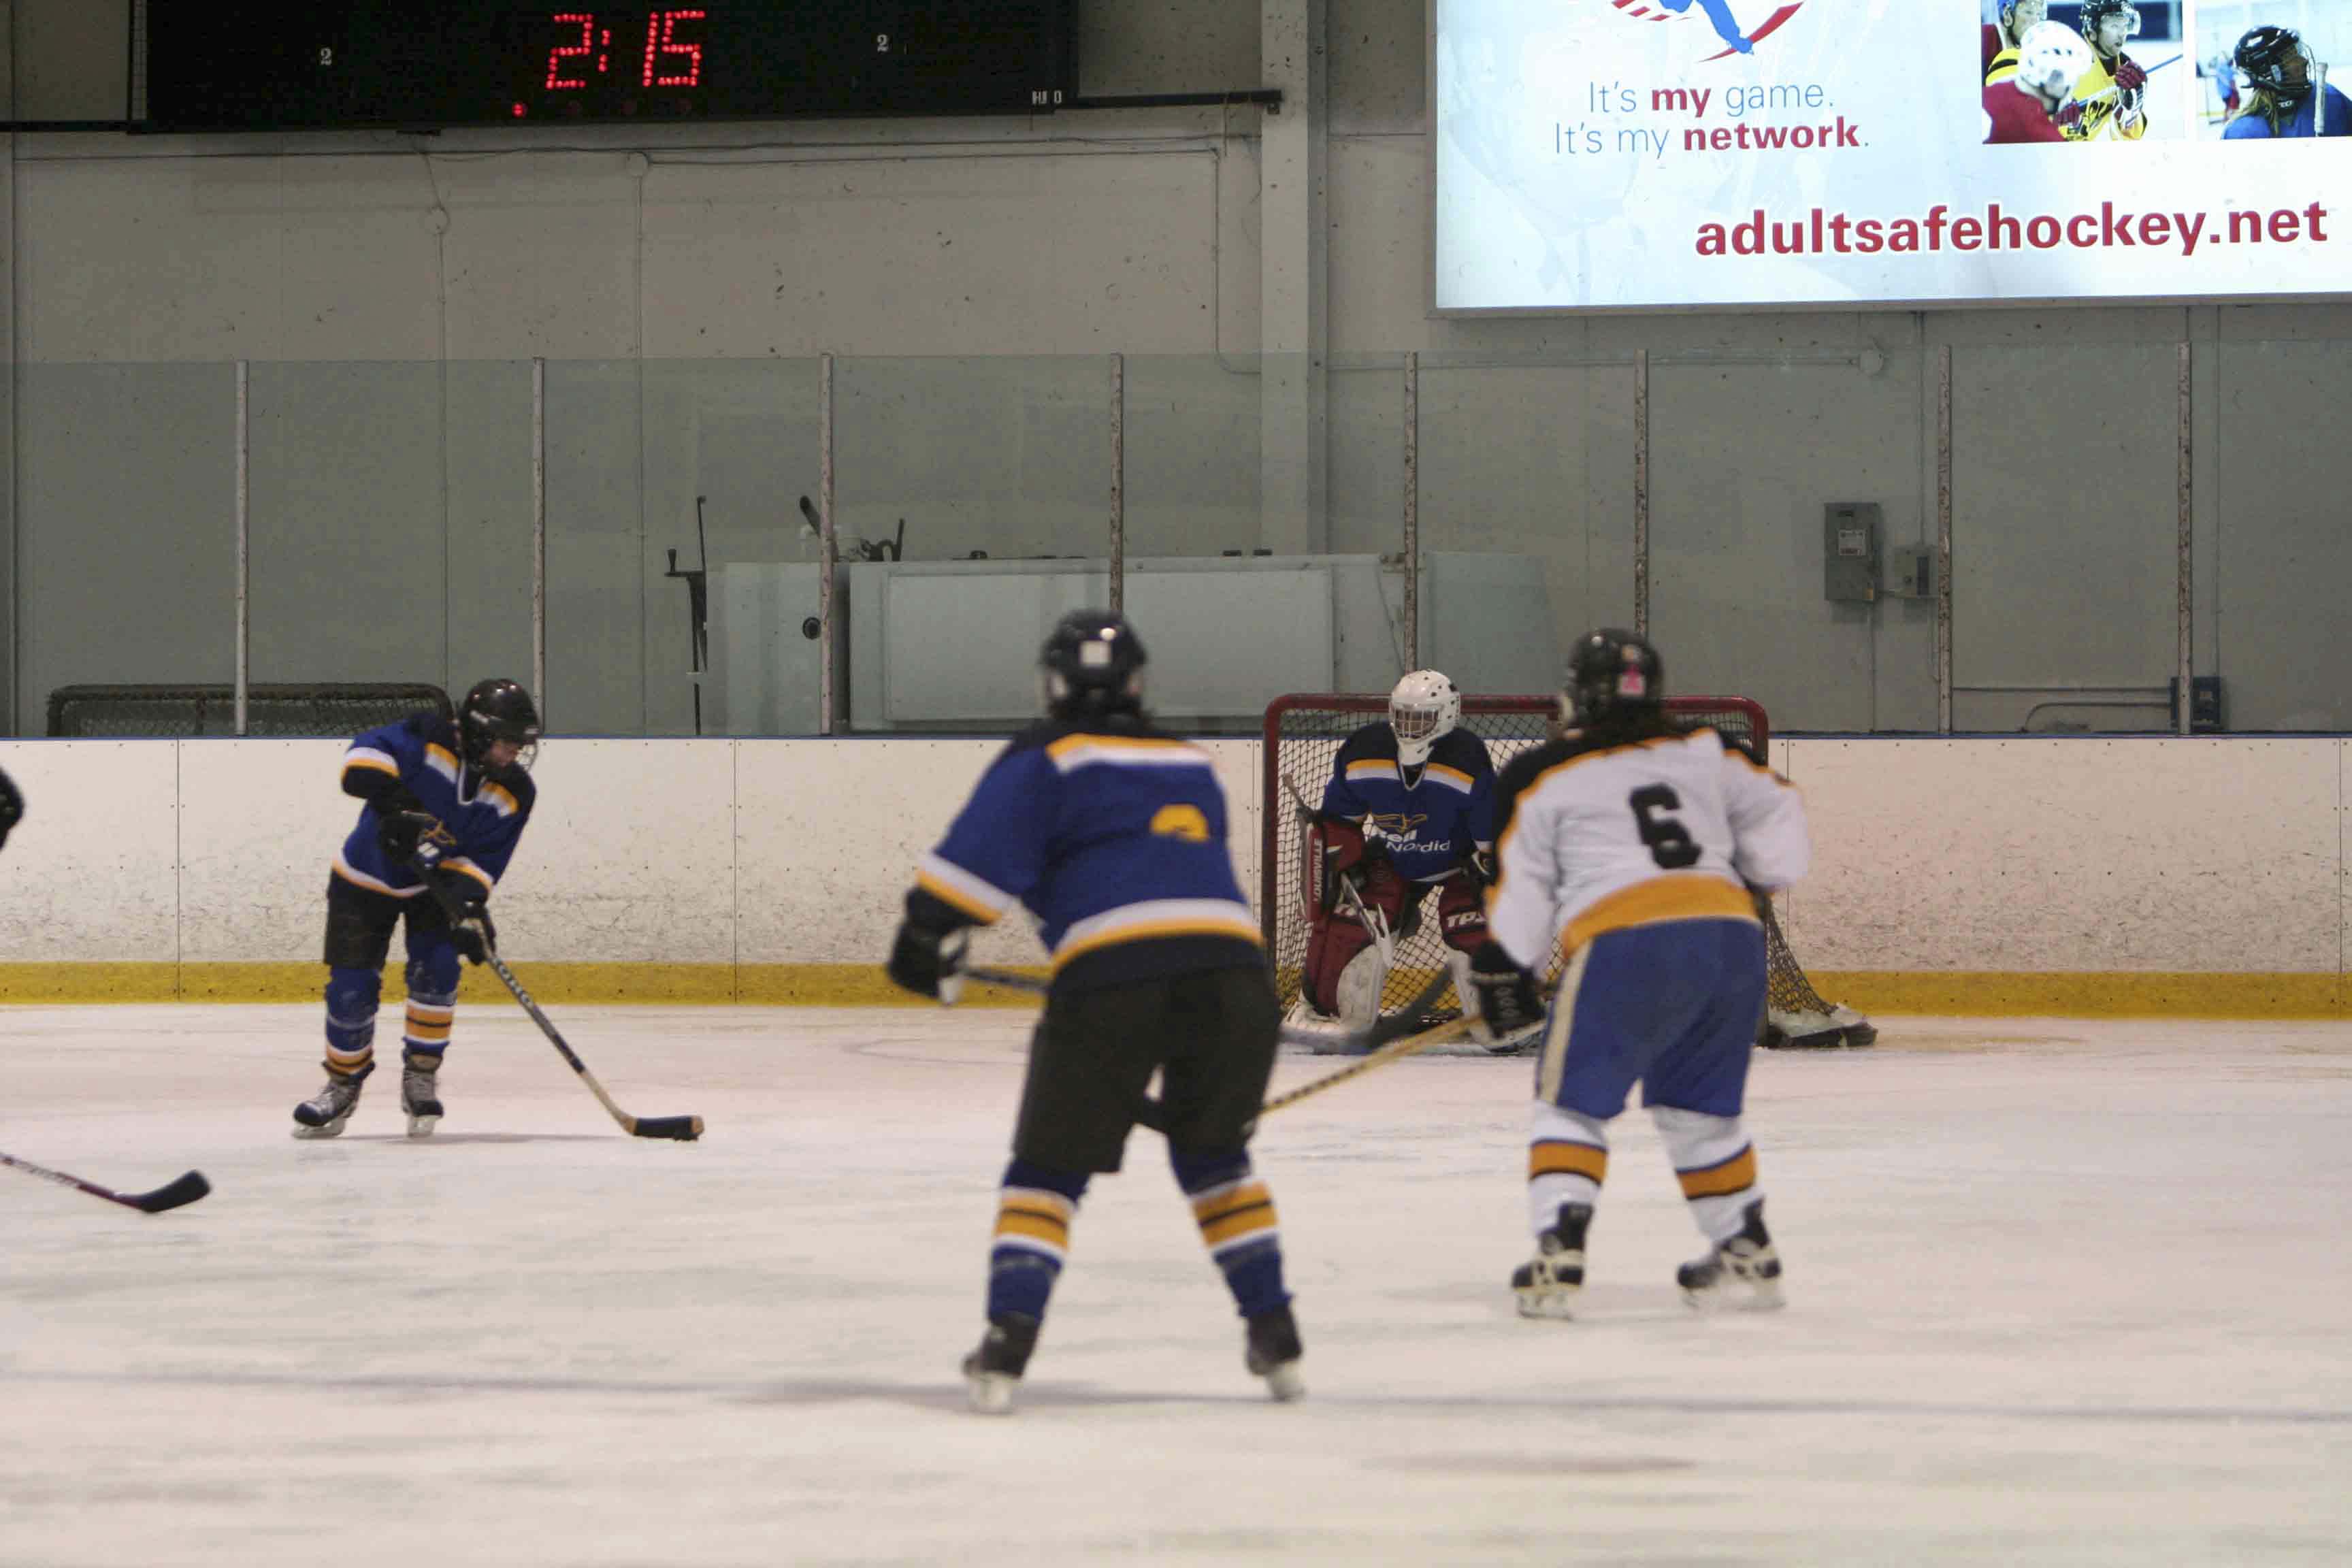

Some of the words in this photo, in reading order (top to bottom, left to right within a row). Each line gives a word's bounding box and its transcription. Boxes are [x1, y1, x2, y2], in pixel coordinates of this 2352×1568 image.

[1590, 80, 1637, 113] It's
[1652, 87, 1712, 118] my
[1725, 82, 1835, 117] game.
[1556, 121, 1603, 154] It's
[1618, 128, 1669, 159] my
[1684, 116, 1869, 151] network.
[1695, 201, 2329, 257] adultsafehockey.net
[1630, 782, 1703, 870] 6
[1313, 838, 1323, 903] LOUISVILLE
